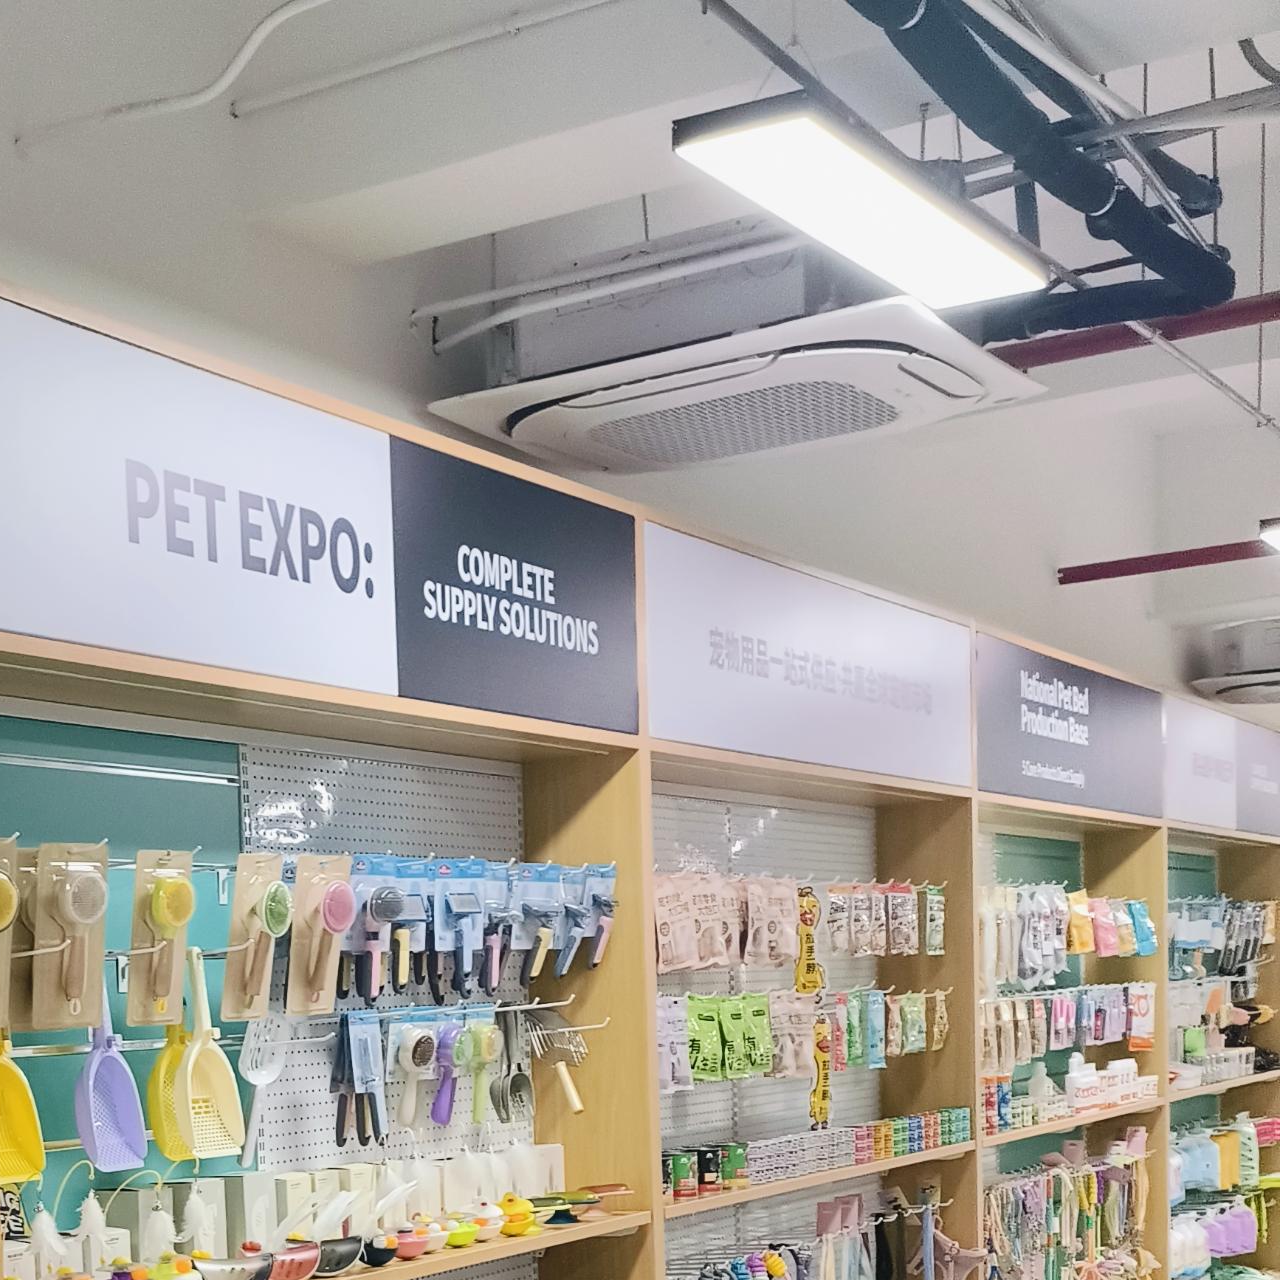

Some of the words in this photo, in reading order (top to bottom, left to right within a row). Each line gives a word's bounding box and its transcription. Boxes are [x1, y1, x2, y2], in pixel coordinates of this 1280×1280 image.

[124, 457, 226, 563] PET
[238, 489, 374, 599] EXPO:
[456, 543, 556, 605] COMPLETE
[423, 579, 499, 632] SUPPLY
[498, 594, 600, 656] SOLUTIONS
[1020, 703, 1070, 742] Production
